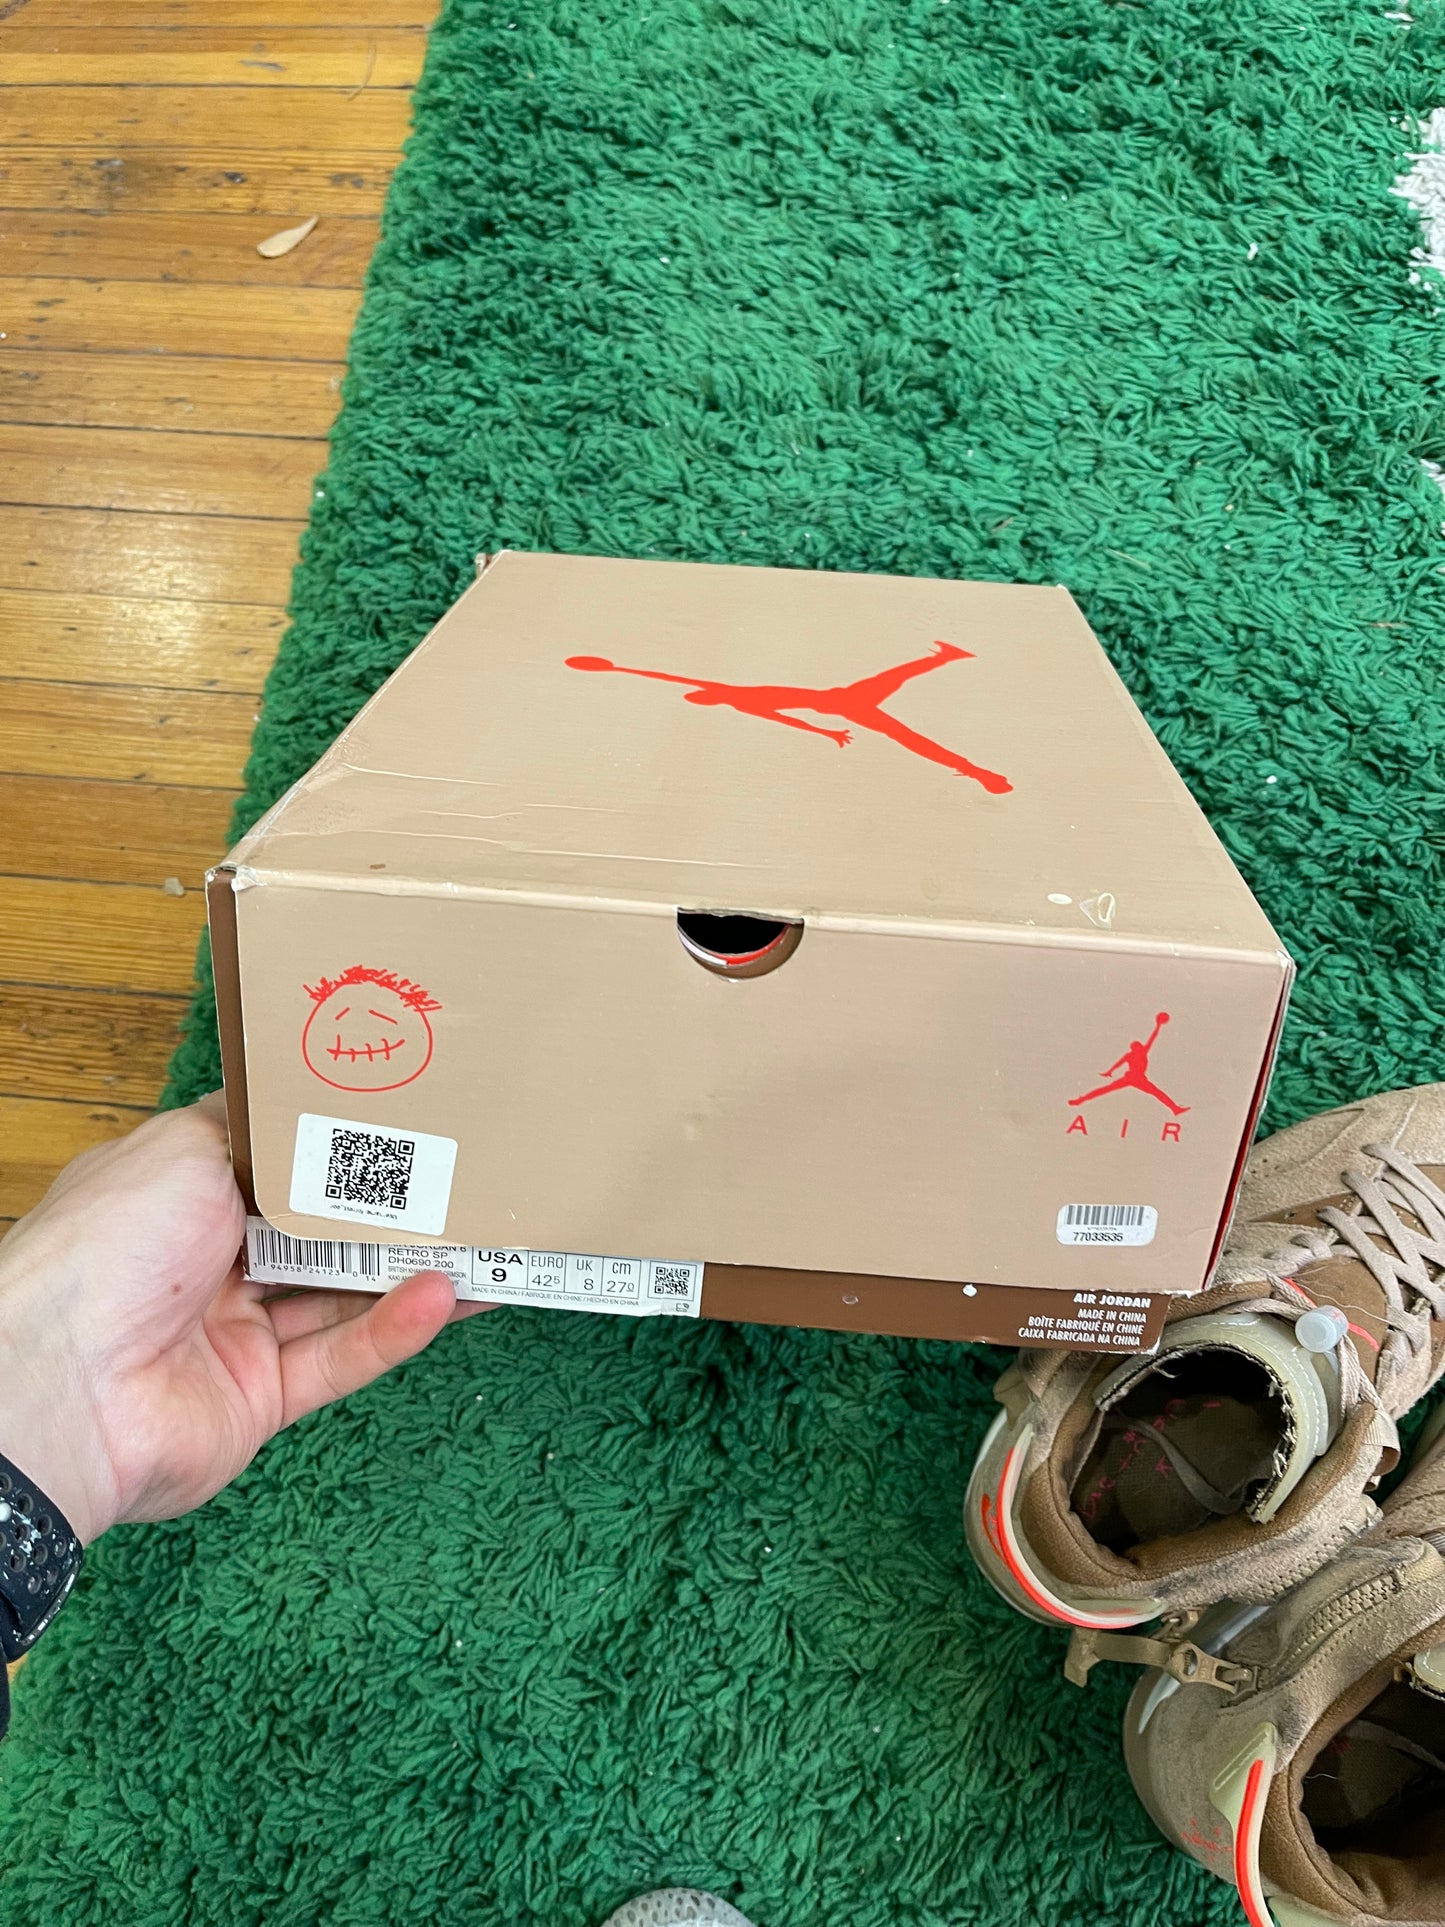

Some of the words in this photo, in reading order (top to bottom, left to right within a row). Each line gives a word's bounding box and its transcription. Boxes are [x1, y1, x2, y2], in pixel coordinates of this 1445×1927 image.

[1067, 1115, 1181, 1142] AIR
[1073, 1231, 1123, 1242] 77033535
[388, 1247, 429, 1258] RETRO
[432, 1251, 448, 1259] SP
[478, 1250, 523, 1265] USA
[388, 1256, 431, 1267] DH0690
[434, 1260, 454, 1269] 200
[531, 1255, 564, 1269] EURO
[576, 1259, 593, 1271] UK
[491, 1268, 507, 1282] 9
[583, 1278, 594, 1291] 8
[1073, 1293, 1097, 1304] AIR
[1099, 1294, 1152, 1308] JORDAN
[1078, 1309, 1105, 1320] MADE
[1106, 1310, 1117, 1320] IN
[1119, 1311, 1147, 1323] CHINA
[1102, 1322, 1115, 1333] EN
[1116, 1323, 1145, 1335] CHINE
[1018, 1328, 1045, 1339] CAIXA
[1047, 1329, 1096, 1343] FABRICADA
[1097, 1333, 1111, 1344] NA
[1113, 1335, 1140, 1346] CHINA
